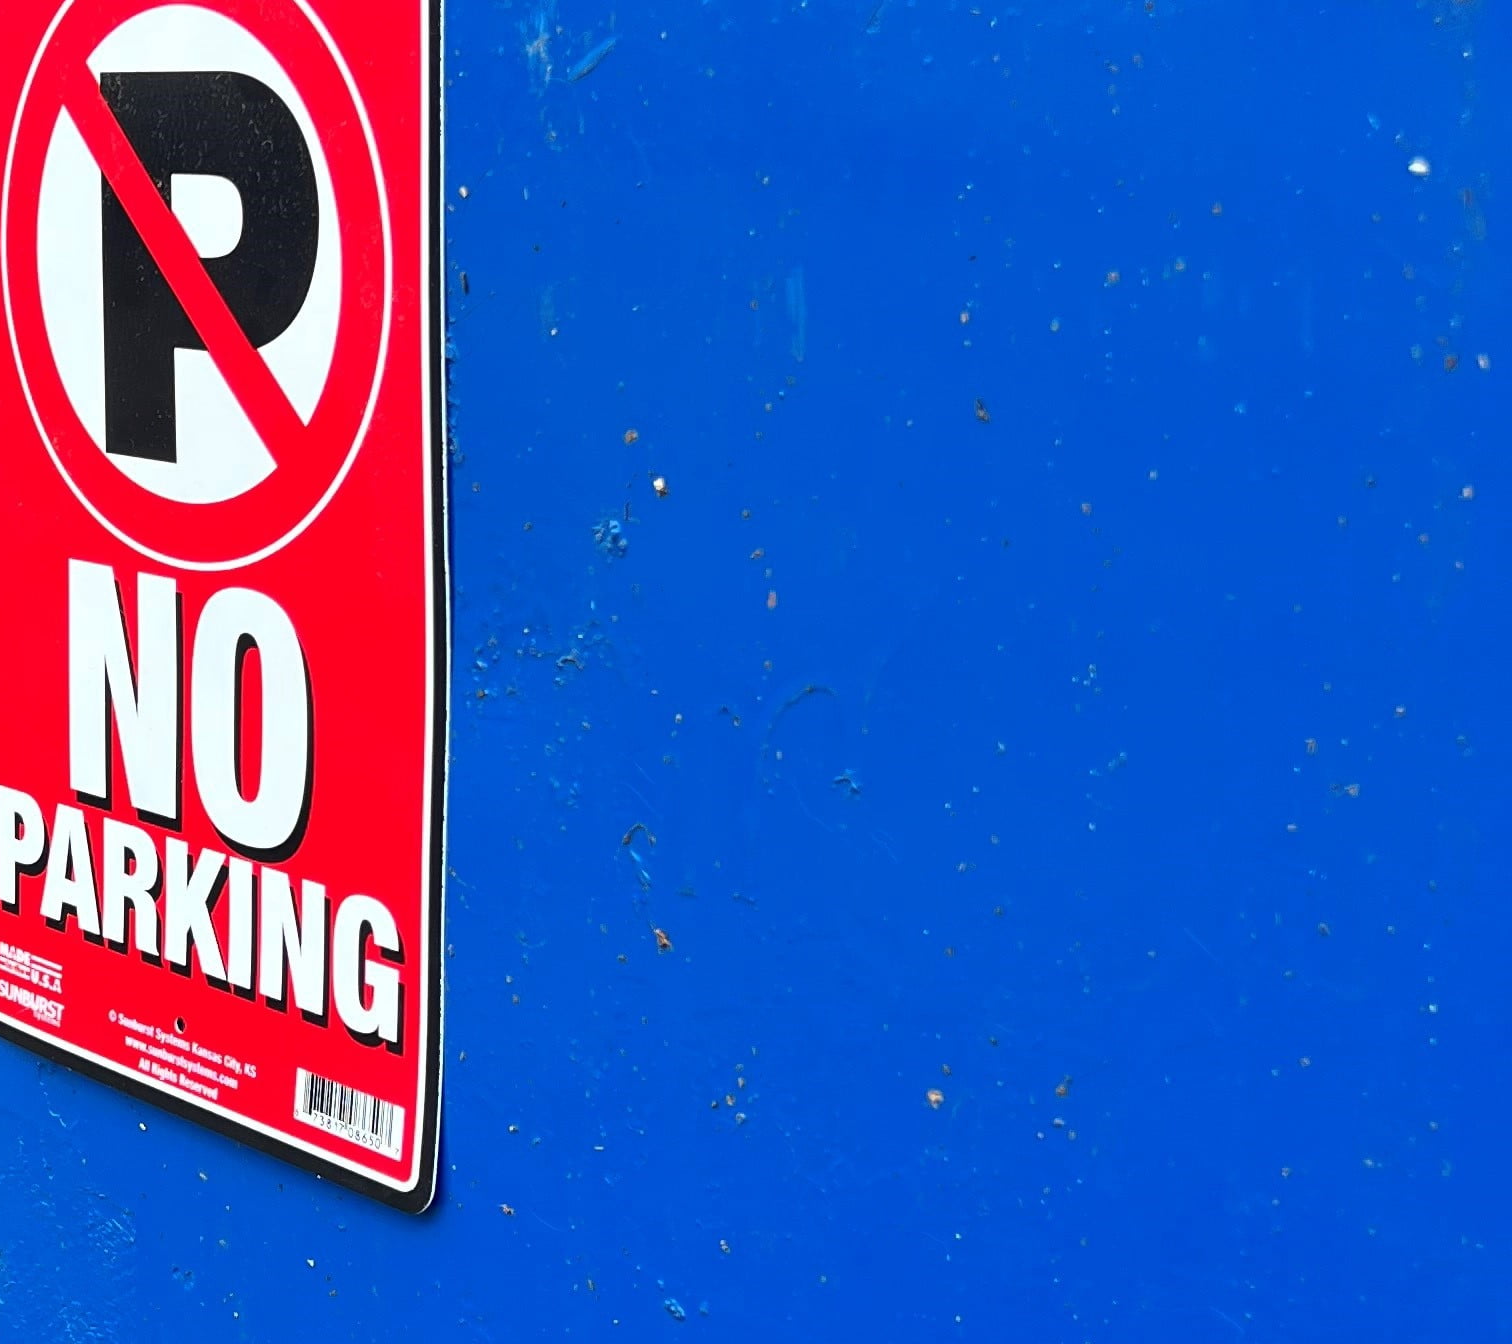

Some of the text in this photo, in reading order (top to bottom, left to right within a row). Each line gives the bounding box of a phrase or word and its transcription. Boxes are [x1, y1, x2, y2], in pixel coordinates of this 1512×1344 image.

[100, 70, 319, 464] P
[68, 558, 314, 862] NO
[118, 1012, 154, 1037] Sunburst
[155, 1027, 190, 1052] Systems
[191, 1041, 223, 1064] Kansas
[244, 1062, 257, 1078] KS
[139, 1057, 219, 1100] All Rights Reserved
